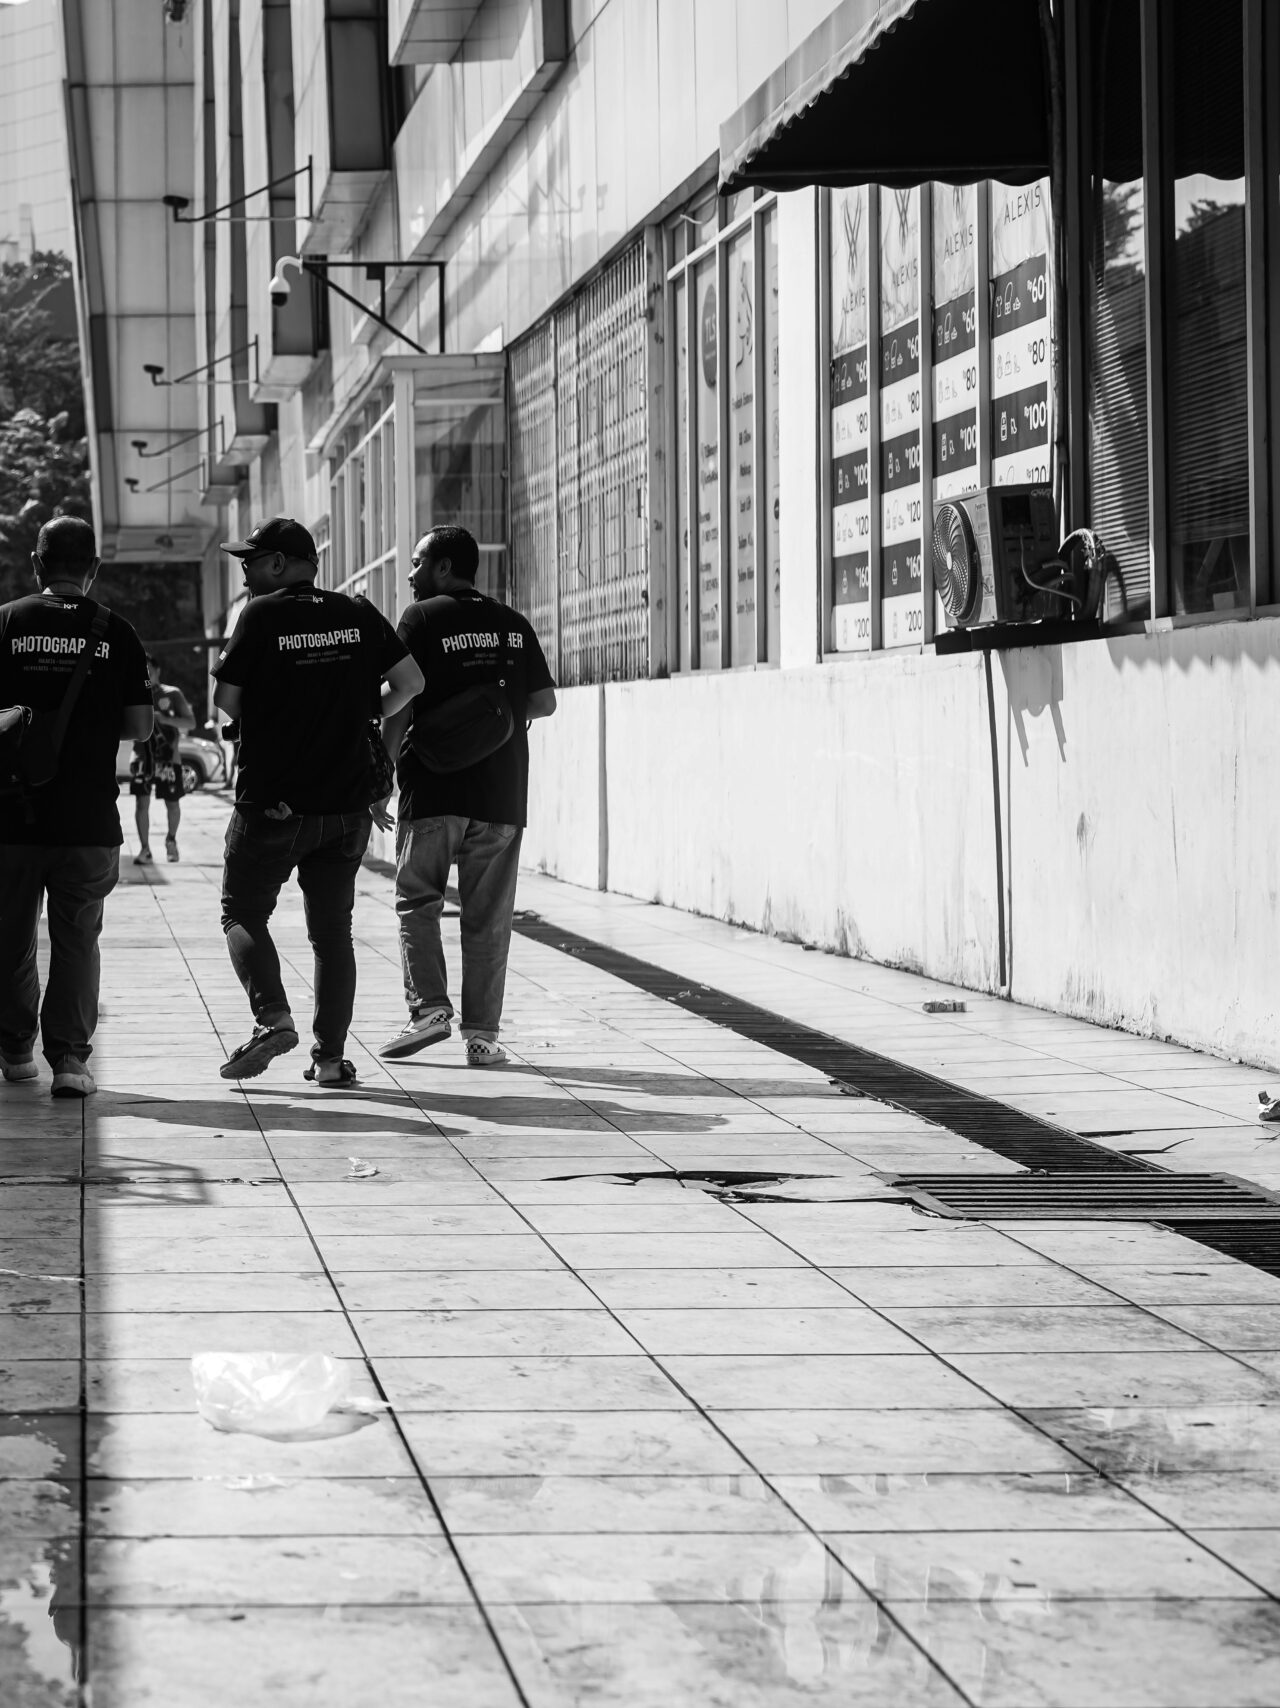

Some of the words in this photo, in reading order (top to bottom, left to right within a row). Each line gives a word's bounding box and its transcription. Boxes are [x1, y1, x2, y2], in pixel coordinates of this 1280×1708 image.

[1004, 185, 1041, 224] ALEXIS
[944, 224, 974, 259] ALEXIS
[11, 635, 110, 660] PHOTOGRAPER
[278, 628, 361, 651] PHOTOGRAPHER
[441, 631, 524, 653] PHOTOGRAHER
